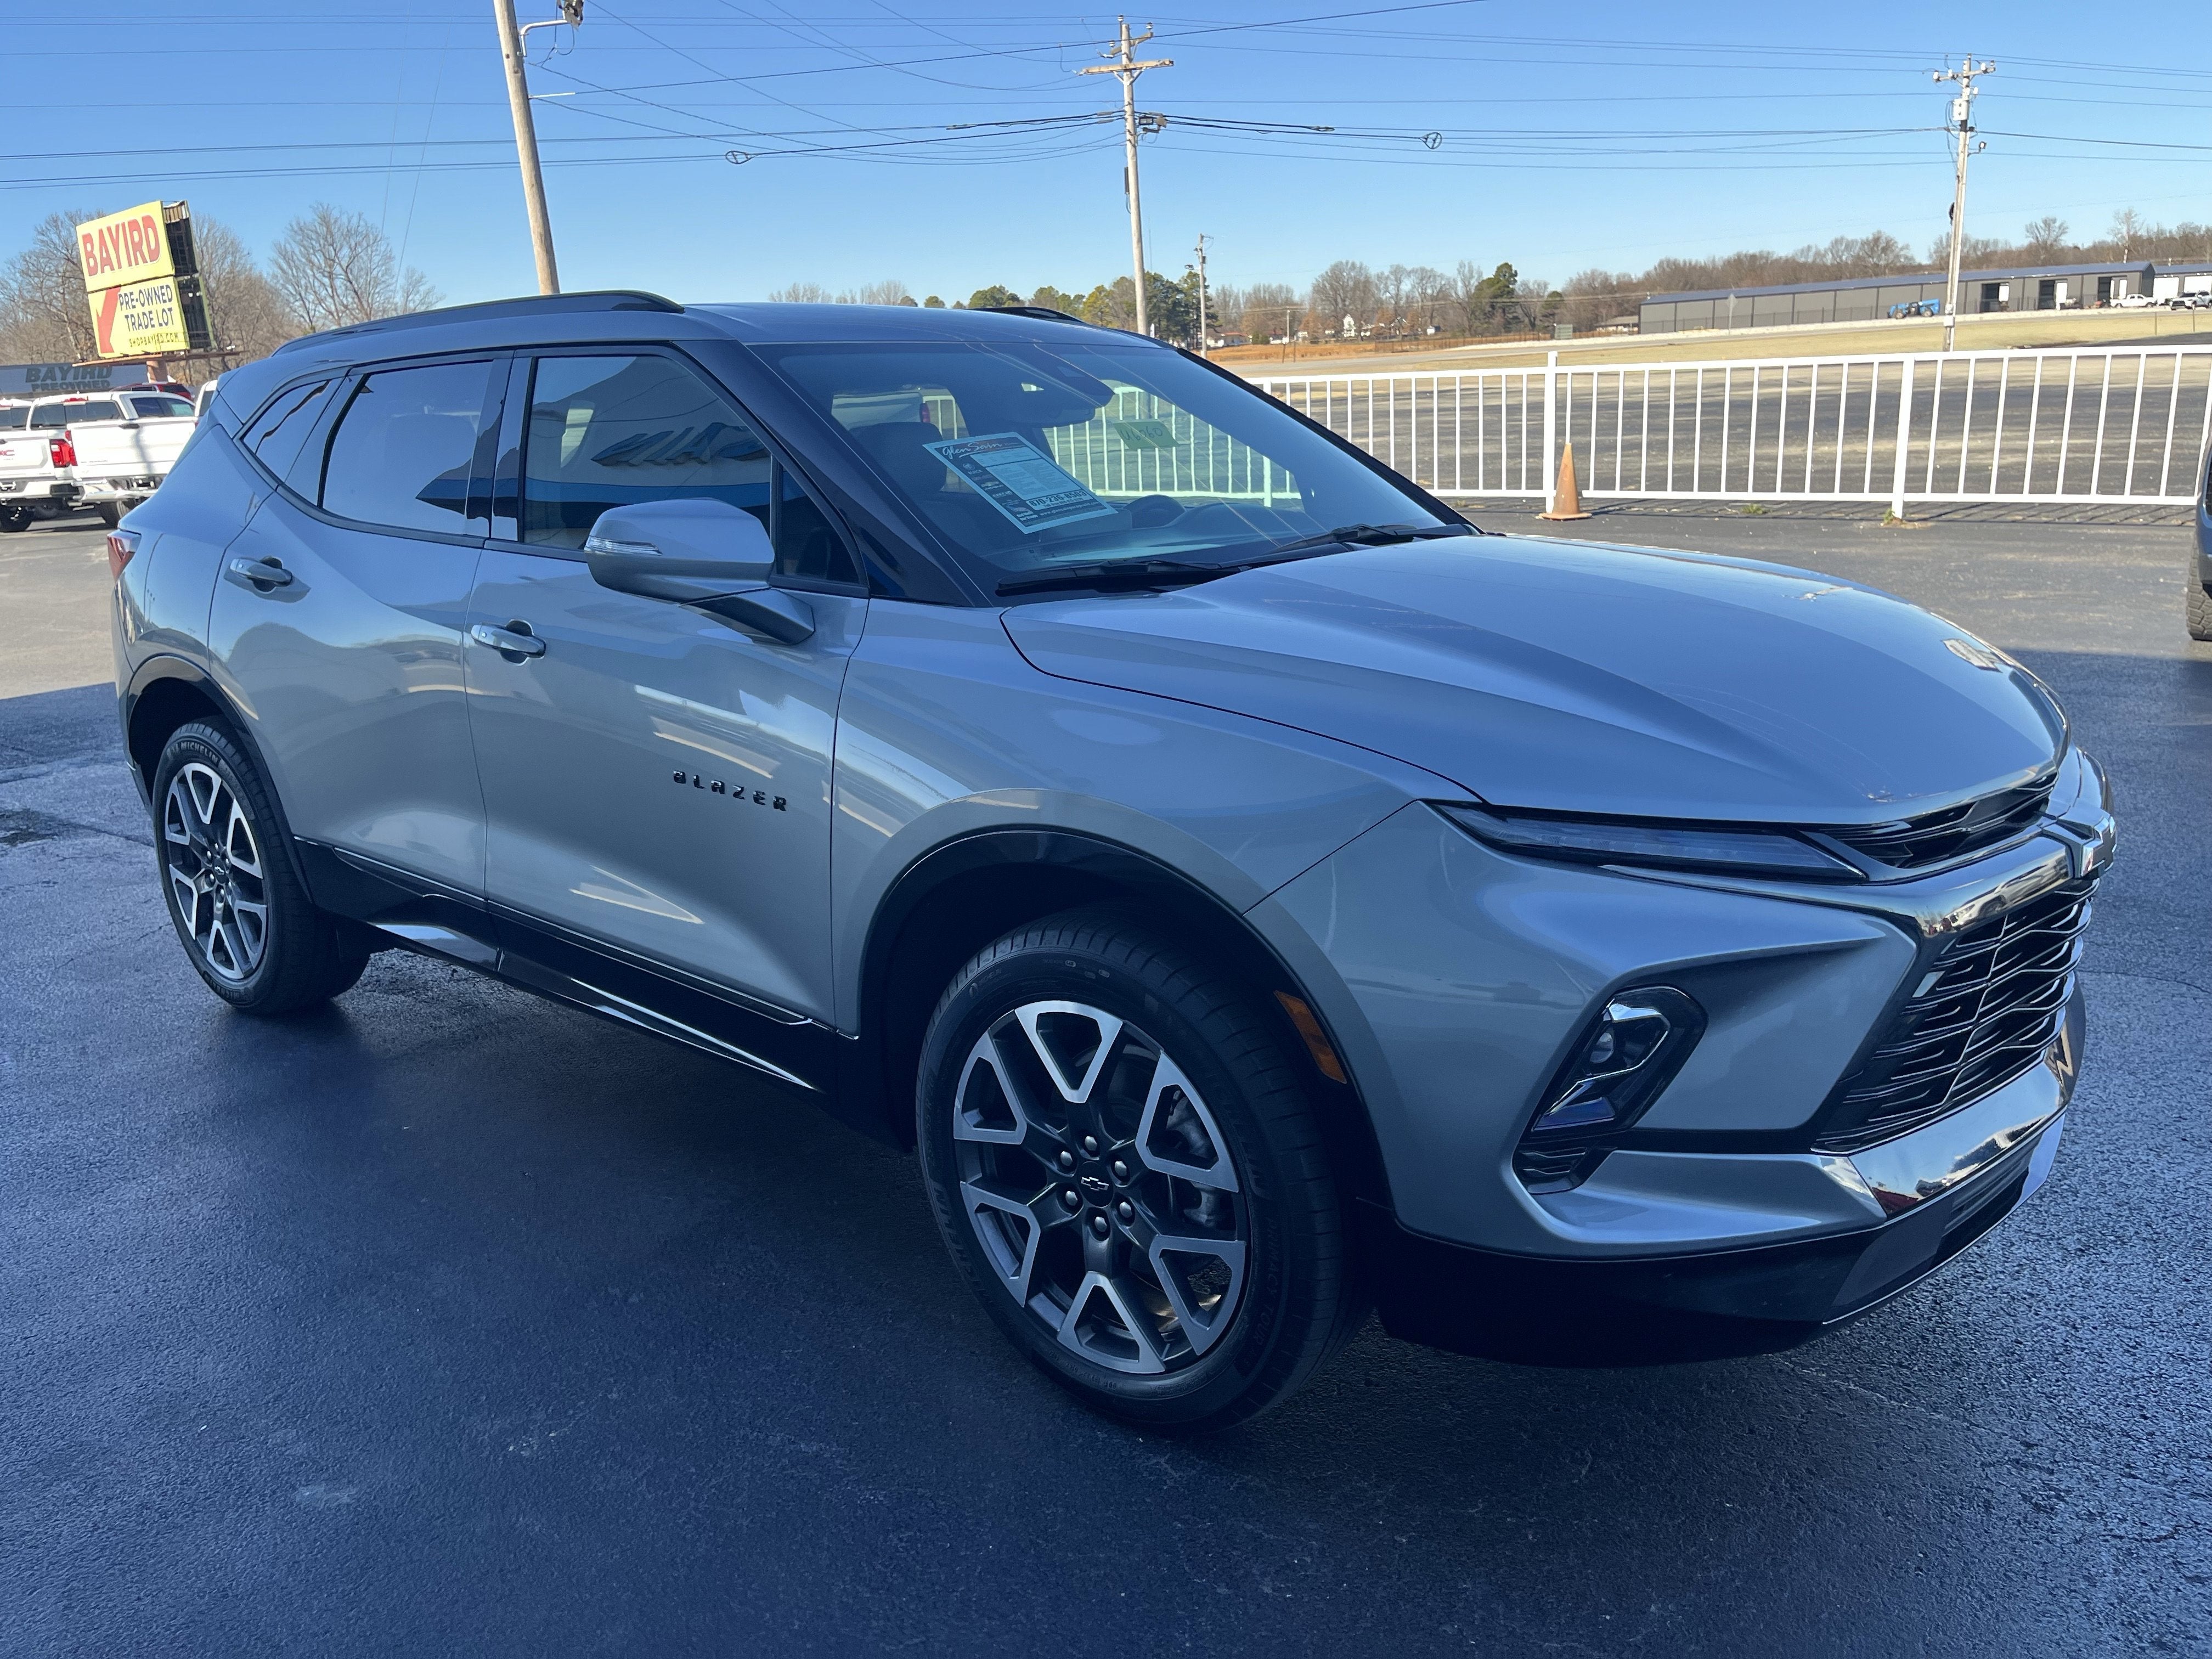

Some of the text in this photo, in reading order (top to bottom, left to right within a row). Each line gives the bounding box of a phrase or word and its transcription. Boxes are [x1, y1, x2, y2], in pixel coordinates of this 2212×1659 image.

[82, 215, 160, 276] BAYIRD
[119, 284, 173, 311] PRE-OWNED
[125, 307, 174, 332] TRADE LOT
[25, 366, 112, 382] BAYIRD
[31, 380, 110, 392] PREOWNED
[943, 445, 971, 460] Glen
[967, 442, 1002, 452] Sain
[180, 741, 219, 765] MICHELIN
[673, 770, 787, 812] BLAZER
